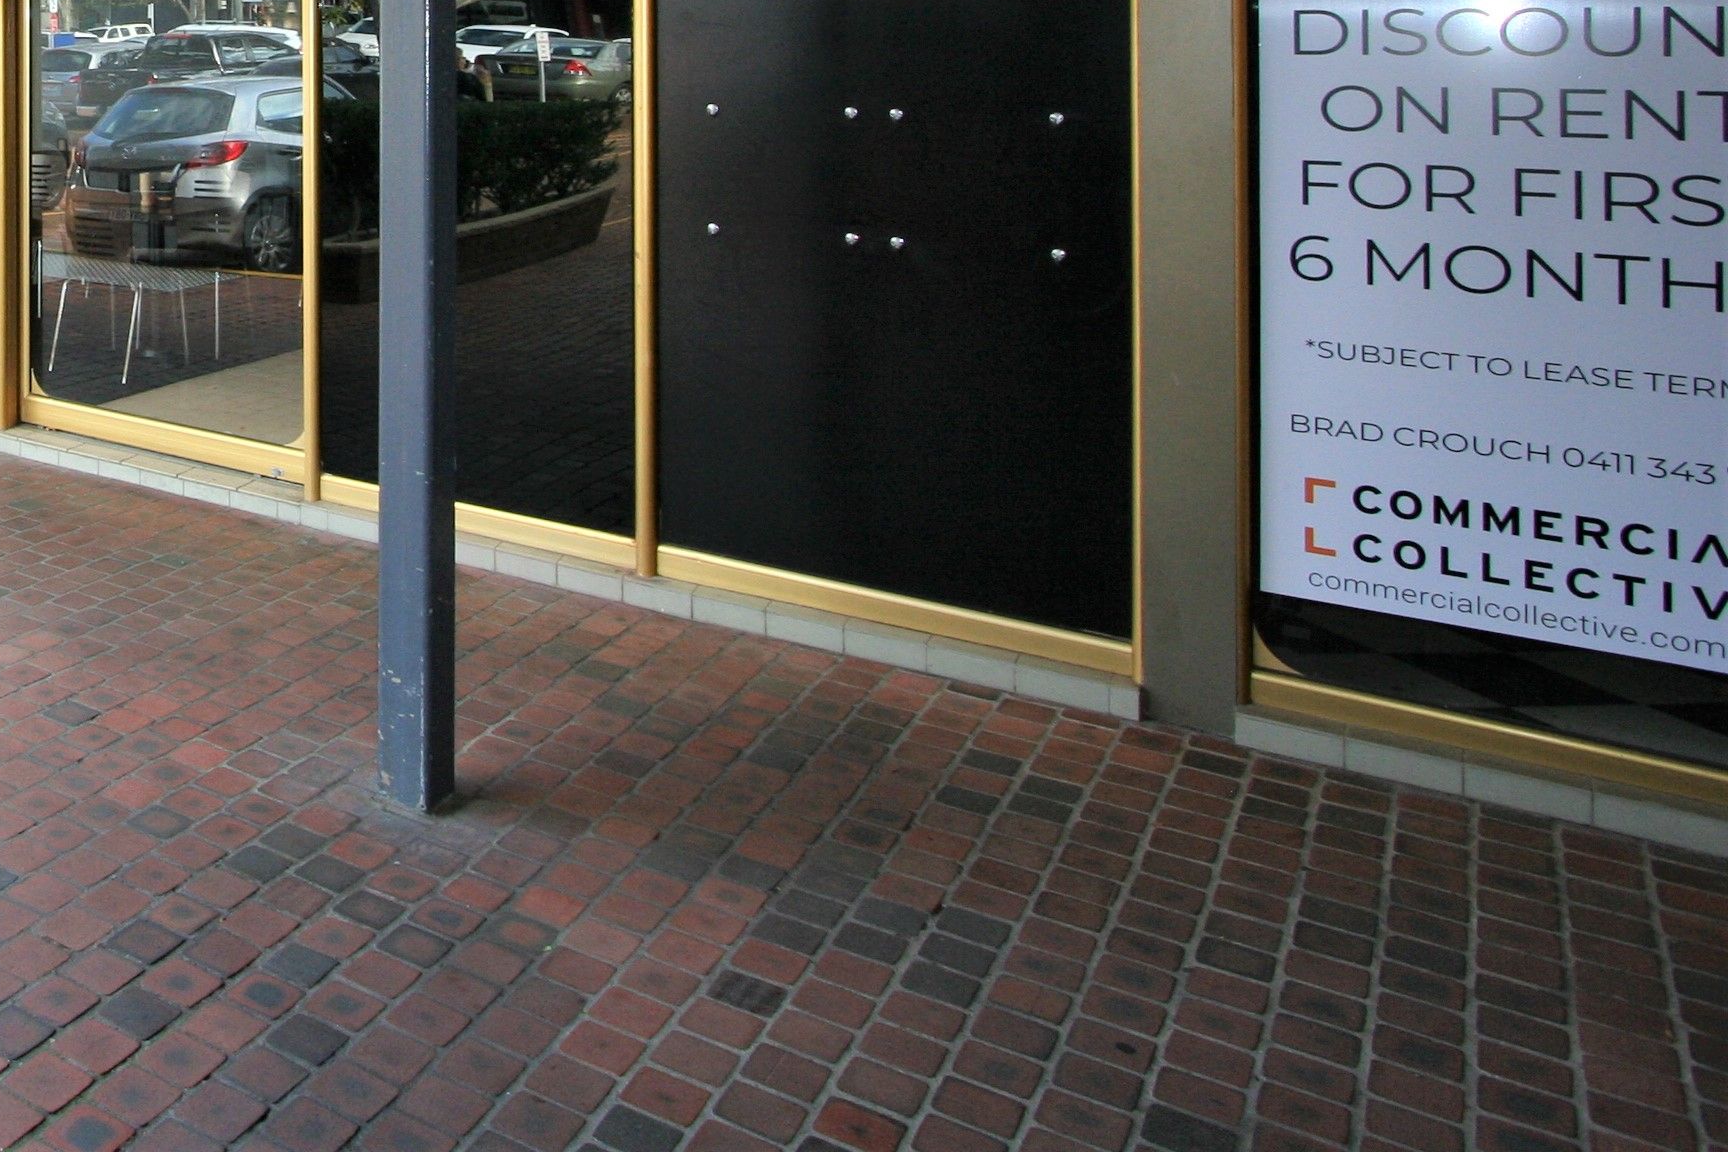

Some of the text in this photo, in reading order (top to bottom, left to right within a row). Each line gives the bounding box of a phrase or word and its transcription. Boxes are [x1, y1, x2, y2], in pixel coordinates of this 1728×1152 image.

[1293, 6, 1725, 57] DISCOUN
[1320, 85, 1728, 143] ON RENT
[1301, 160, 1728, 227] FOR FIRS
[1289, 234, 1725, 313] 6 MONTH
[1466, 354, 1513, 377] TO
[1524, 360, 1634, 390] LEASE
[1290, 413, 1717, 485] BRAD CROUCH 0411 343
[1352, 485, 1728, 568] COMMERCIA
[1352, 534, 1728, 621] COLLECTIV
